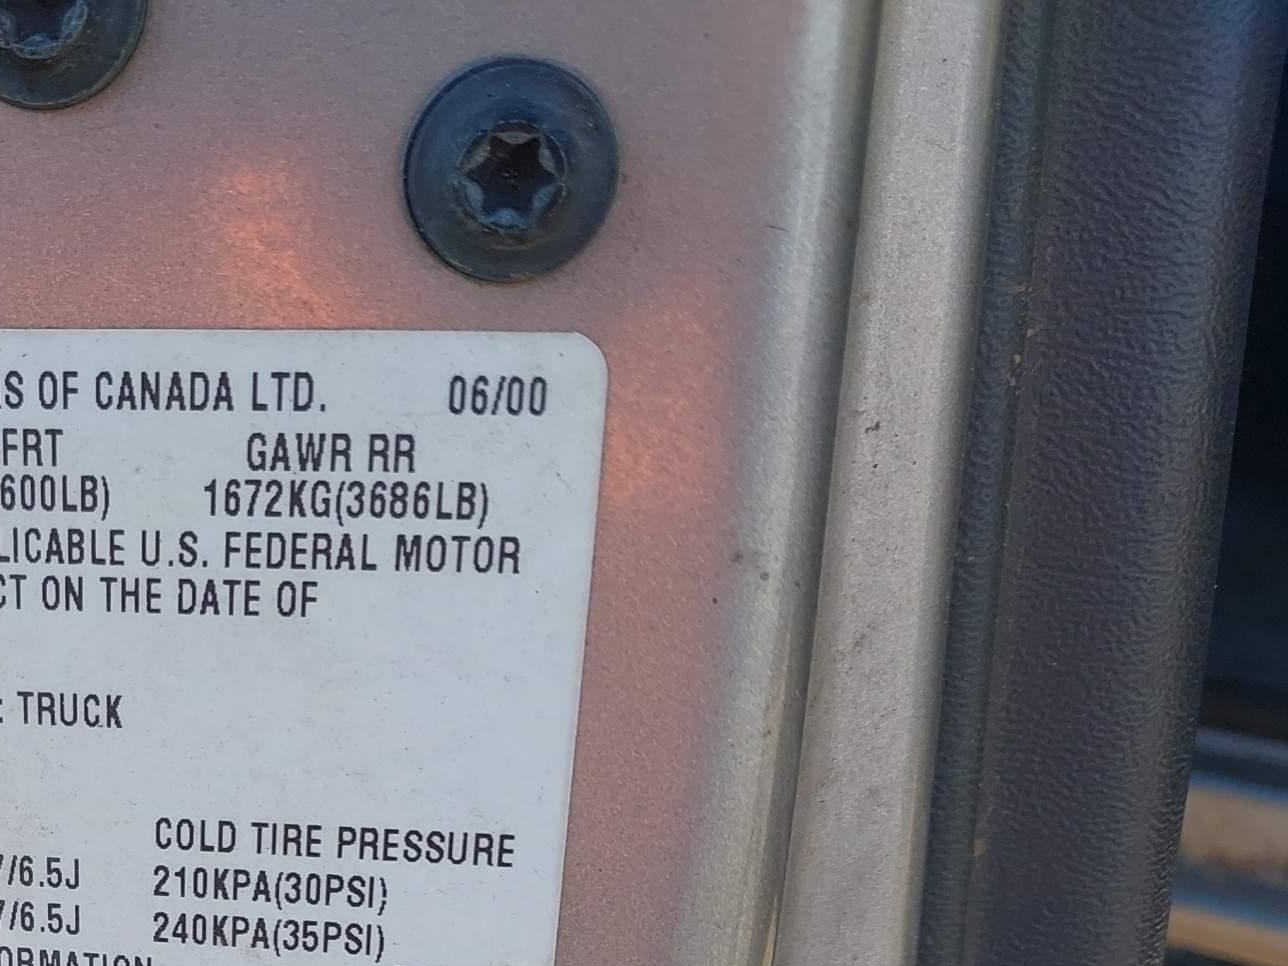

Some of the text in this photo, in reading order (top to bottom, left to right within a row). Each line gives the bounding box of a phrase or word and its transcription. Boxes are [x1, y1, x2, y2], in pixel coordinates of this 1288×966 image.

[39, 371, 78, 409] OF
[96, 371, 234, 411] CANADA
[252, 372, 326, 412] LTD.
[449, 375, 547, 416] 06/00
[2, 428, 63, 467] FRT
[247, 432, 415, 473] GAWR RR
[204, 479, 488, 529] 1672KG(3686LB)
[141, 530, 207, 567] U.S.
[225, 531, 377, 571] FEDERAL
[395, 534, 520, 574] MOTOR
[42, 575, 83, 611] ON
[100, 577, 161, 613] THE
[178, 578, 260, 616] DATE
[277, 581, 318, 617] OF
[17, 691, 122, 728] TRUCK
[156, 818, 236, 853] COLD
[251, 822, 322, 857] TIRE
[337, 826, 515, 867] PRESSURE
[154, 865, 387, 916] 210KPA(30PSI)
[153, 912, 384, 963] 240KPA(35PSI)
